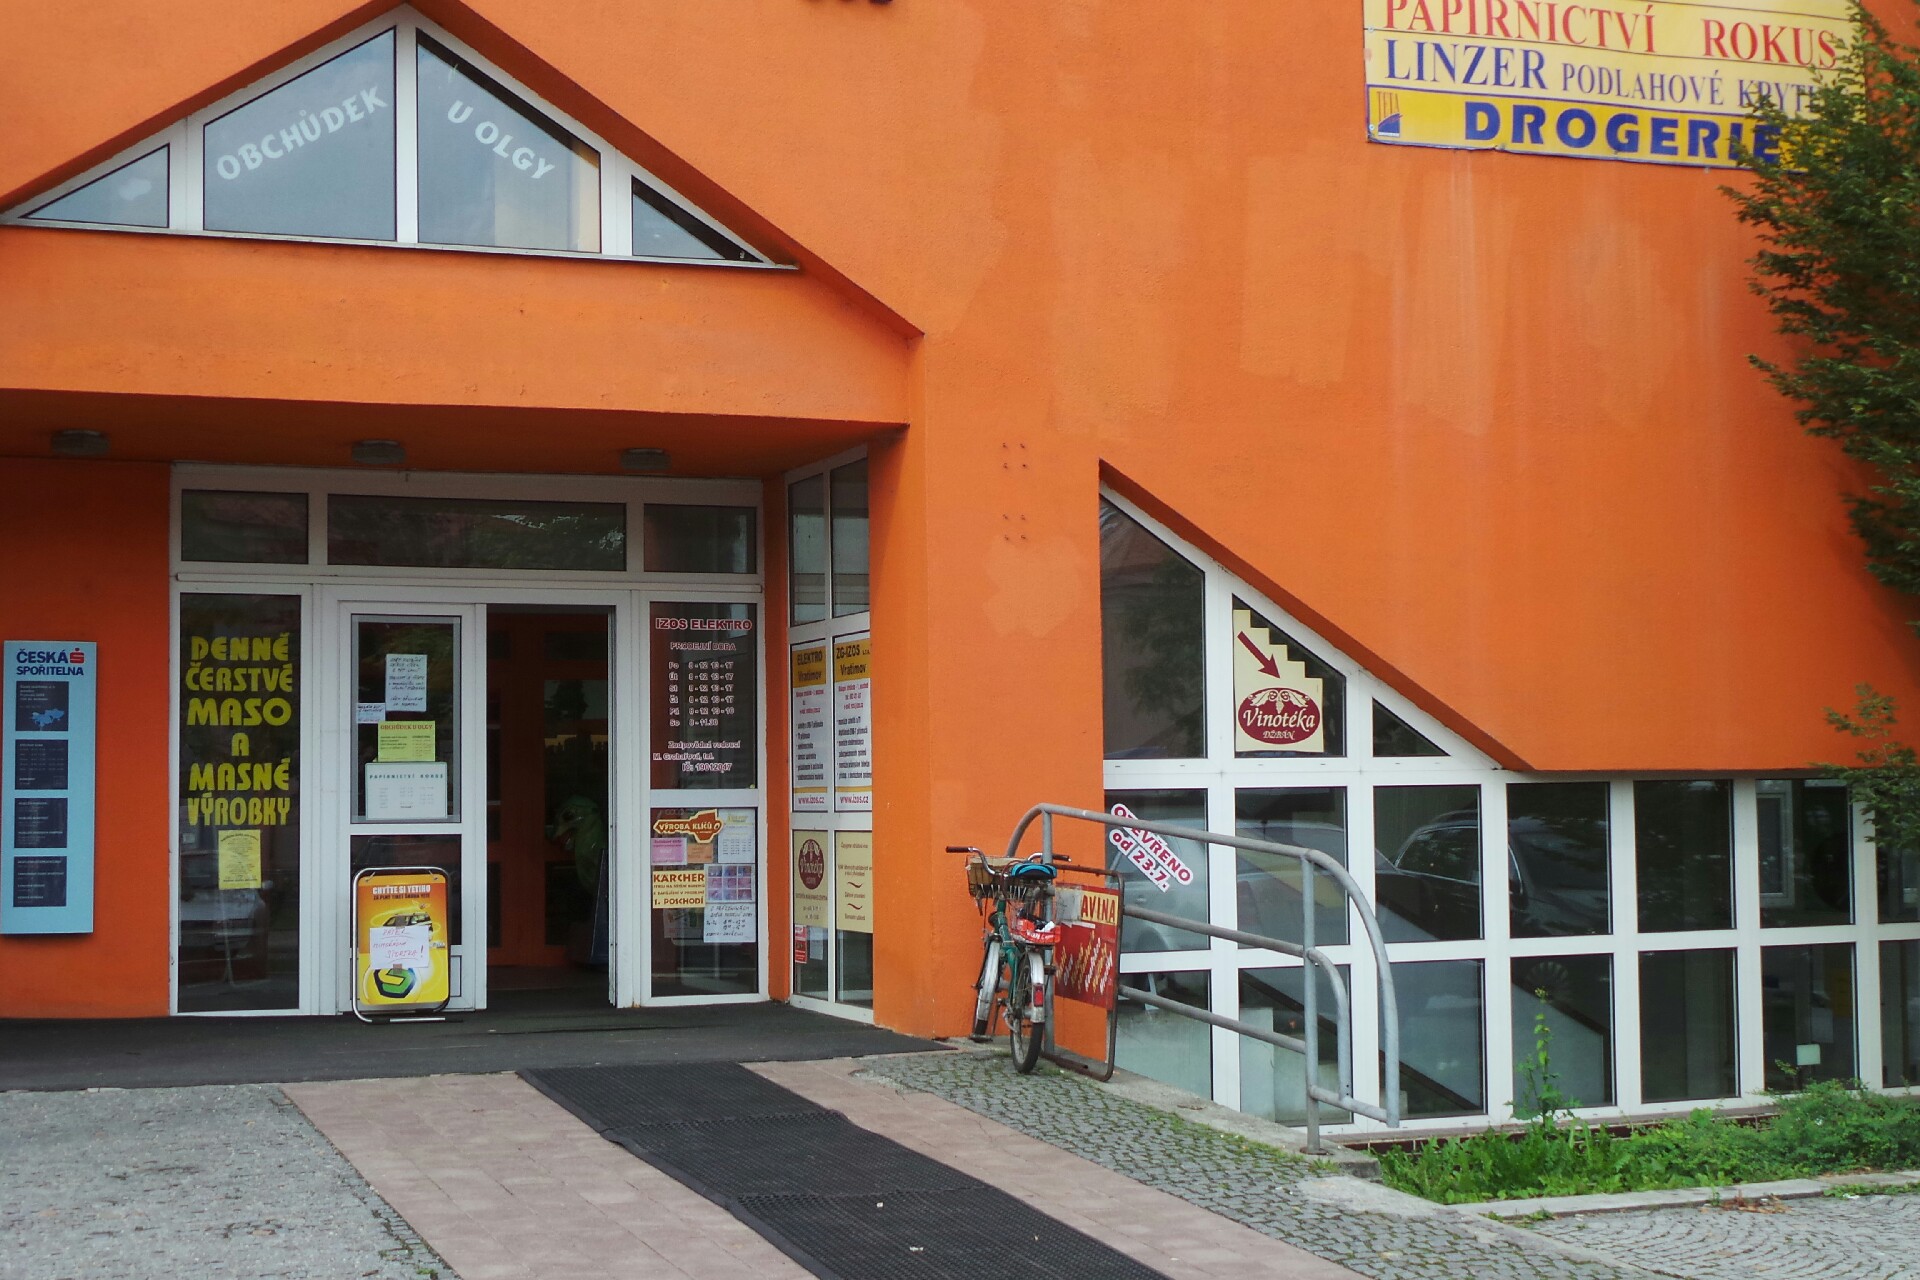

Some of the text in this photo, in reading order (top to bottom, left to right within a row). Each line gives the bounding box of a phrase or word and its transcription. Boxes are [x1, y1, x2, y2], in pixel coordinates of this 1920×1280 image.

[1702, 18, 1837, 69] ROKUS
[1384, 39, 1549, 90] LINZER
[1561, 62, 1725, 106] PODLAHOVÉ
[216, 86, 388, 181] OBCHŮDEK
[447, 100, 556, 180] U OLGY
[1465, 101, 1782, 164] DROGERIE
[656, 618, 752, 630] IZOS ELEKTRO
[16, 648, 69, 664] ČESKÁ
[16, 663, 84, 676] SPOŘITELNA
[185, 661, 293, 693] ČERSTVÉ
[187, 697, 292, 726] MASO
[1243, 707, 1316, 732] Vinotéka
[231, 732, 250, 756] A
[1262, 729, 1296, 741] DŽBÁN
[189, 757, 290, 791] MASNÉ
[187, 791, 291, 826] VÝROBKY
[659, 821, 712, 830] VÝROBA KLÍČŮ
[1113, 833, 1167, 889] od 23.7.
[664, 896, 704, 905] POSCHODÍ
